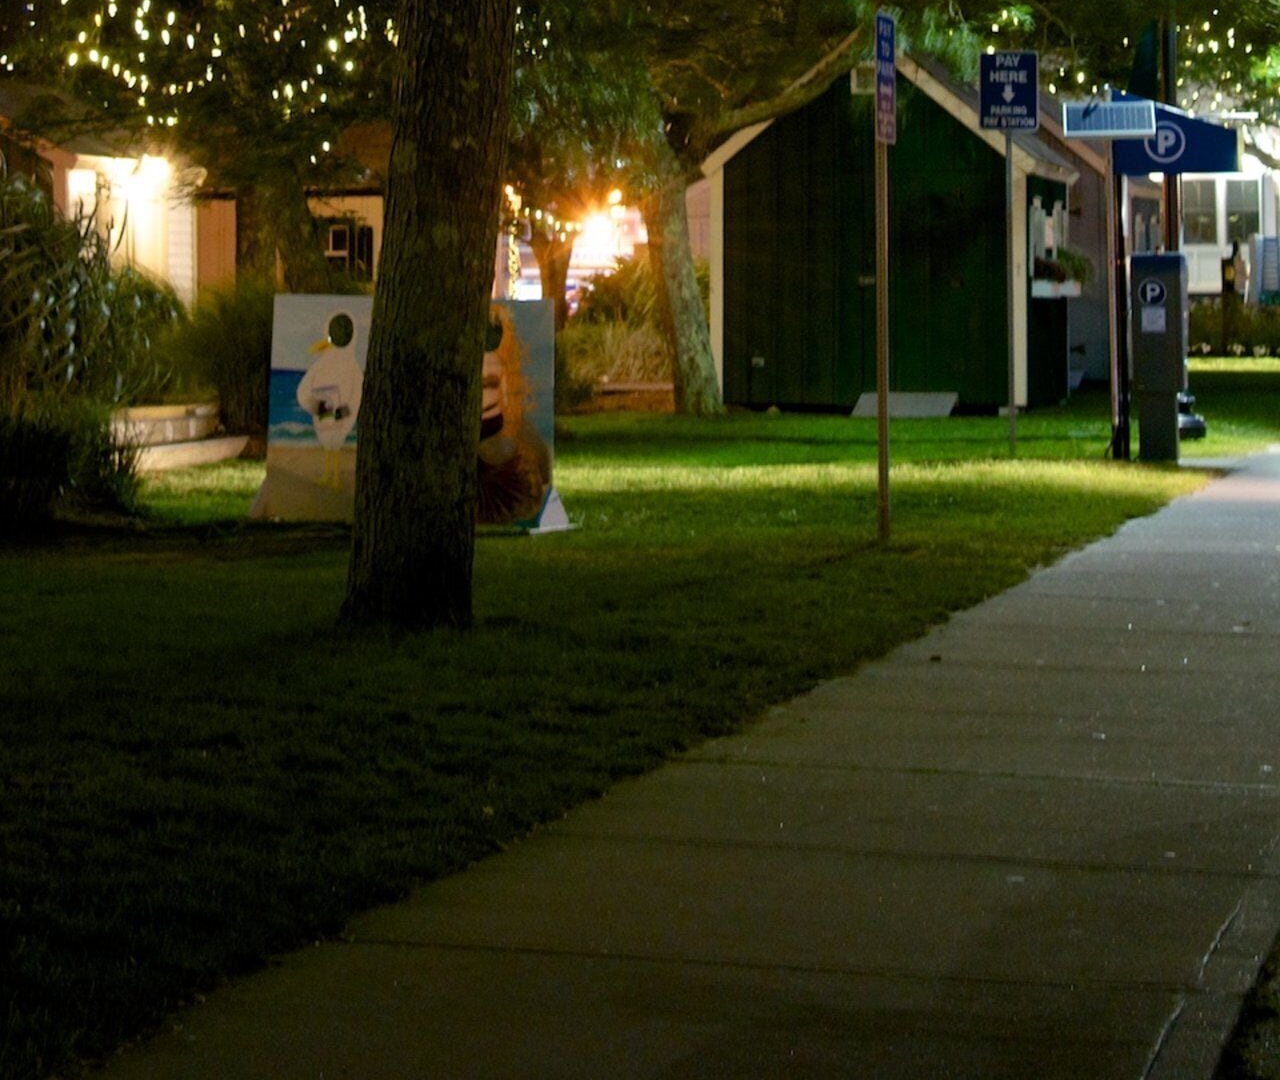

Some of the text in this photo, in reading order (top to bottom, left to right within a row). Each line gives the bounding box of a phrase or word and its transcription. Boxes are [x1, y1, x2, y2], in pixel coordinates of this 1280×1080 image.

[995, 53, 1020, 68] PAY
[989, 70, 1028, 84] HERE
[990, 104, 1028, 116] PARKING
[983, 116, 1036, 128] PAY STATION
[1156, 129, 1176, 156] P
